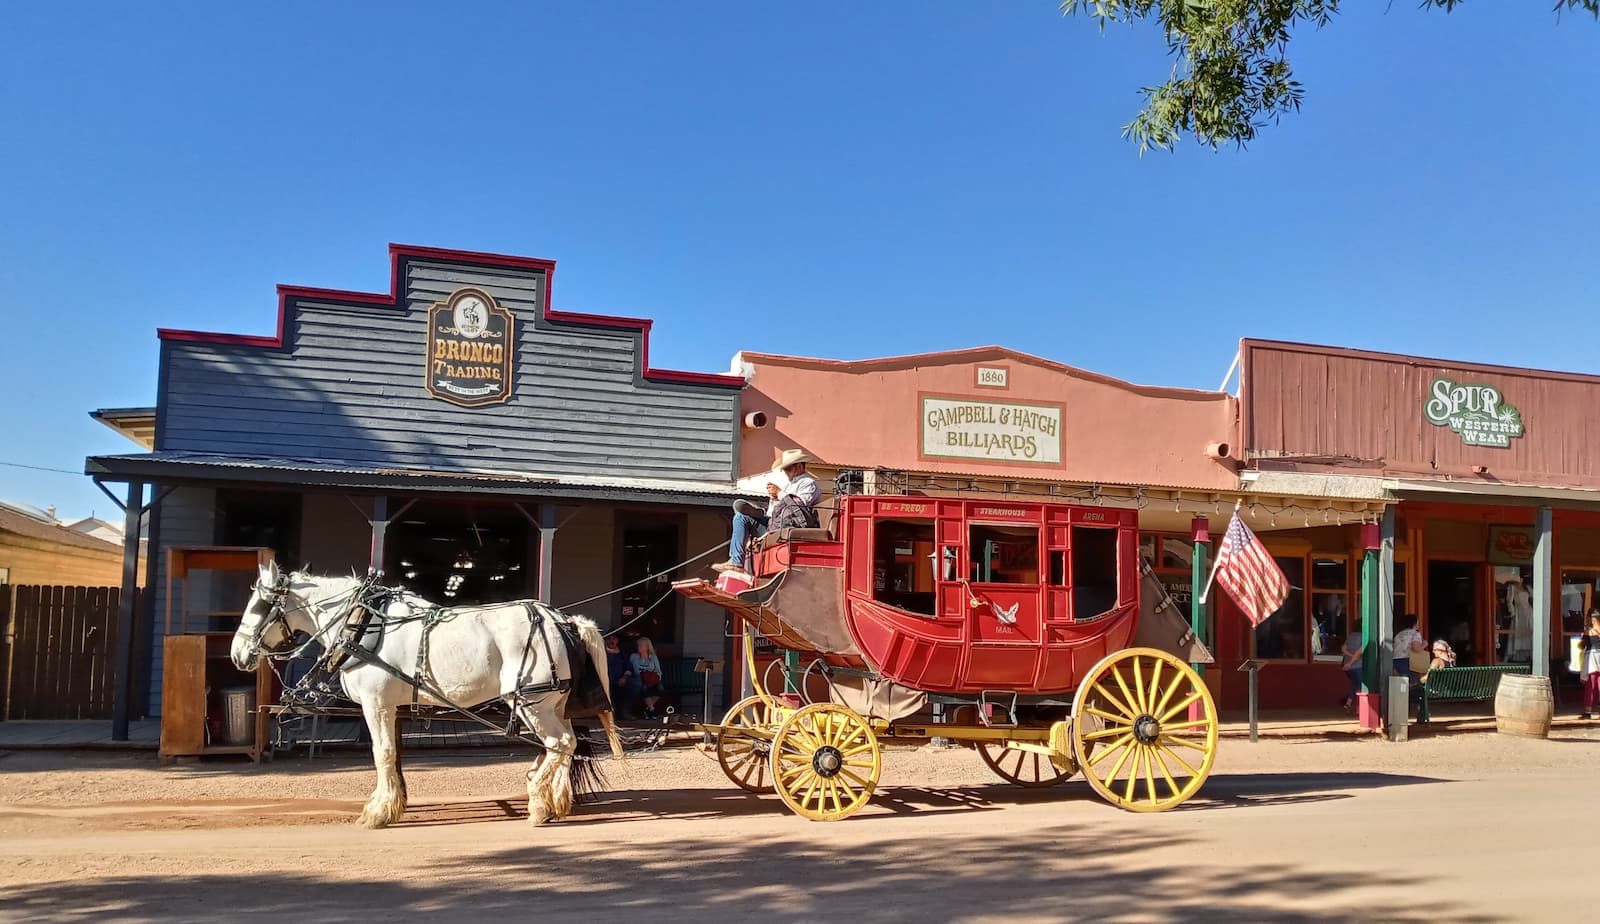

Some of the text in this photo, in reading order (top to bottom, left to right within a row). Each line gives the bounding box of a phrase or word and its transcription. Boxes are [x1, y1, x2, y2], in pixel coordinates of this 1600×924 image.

[434, 339, 503, 364] BRONCO
[433, 360, 501, 379] TRADING
[981, 371, 1004, 383] 1880
[1427, 380, 1499, 420] SPUR
[928, 406, 1057, 438] CAMPBELL & HATCH
[1449, 417, 1521, 434] WESTERN
[946, 431, 1037, 458] BILLIARDS
[1463, 429, 1507, 444] WEAR
[980, 507, 1026, 517] STEAKHOUSE
[1082, 512, 1105, 521] ARENA
